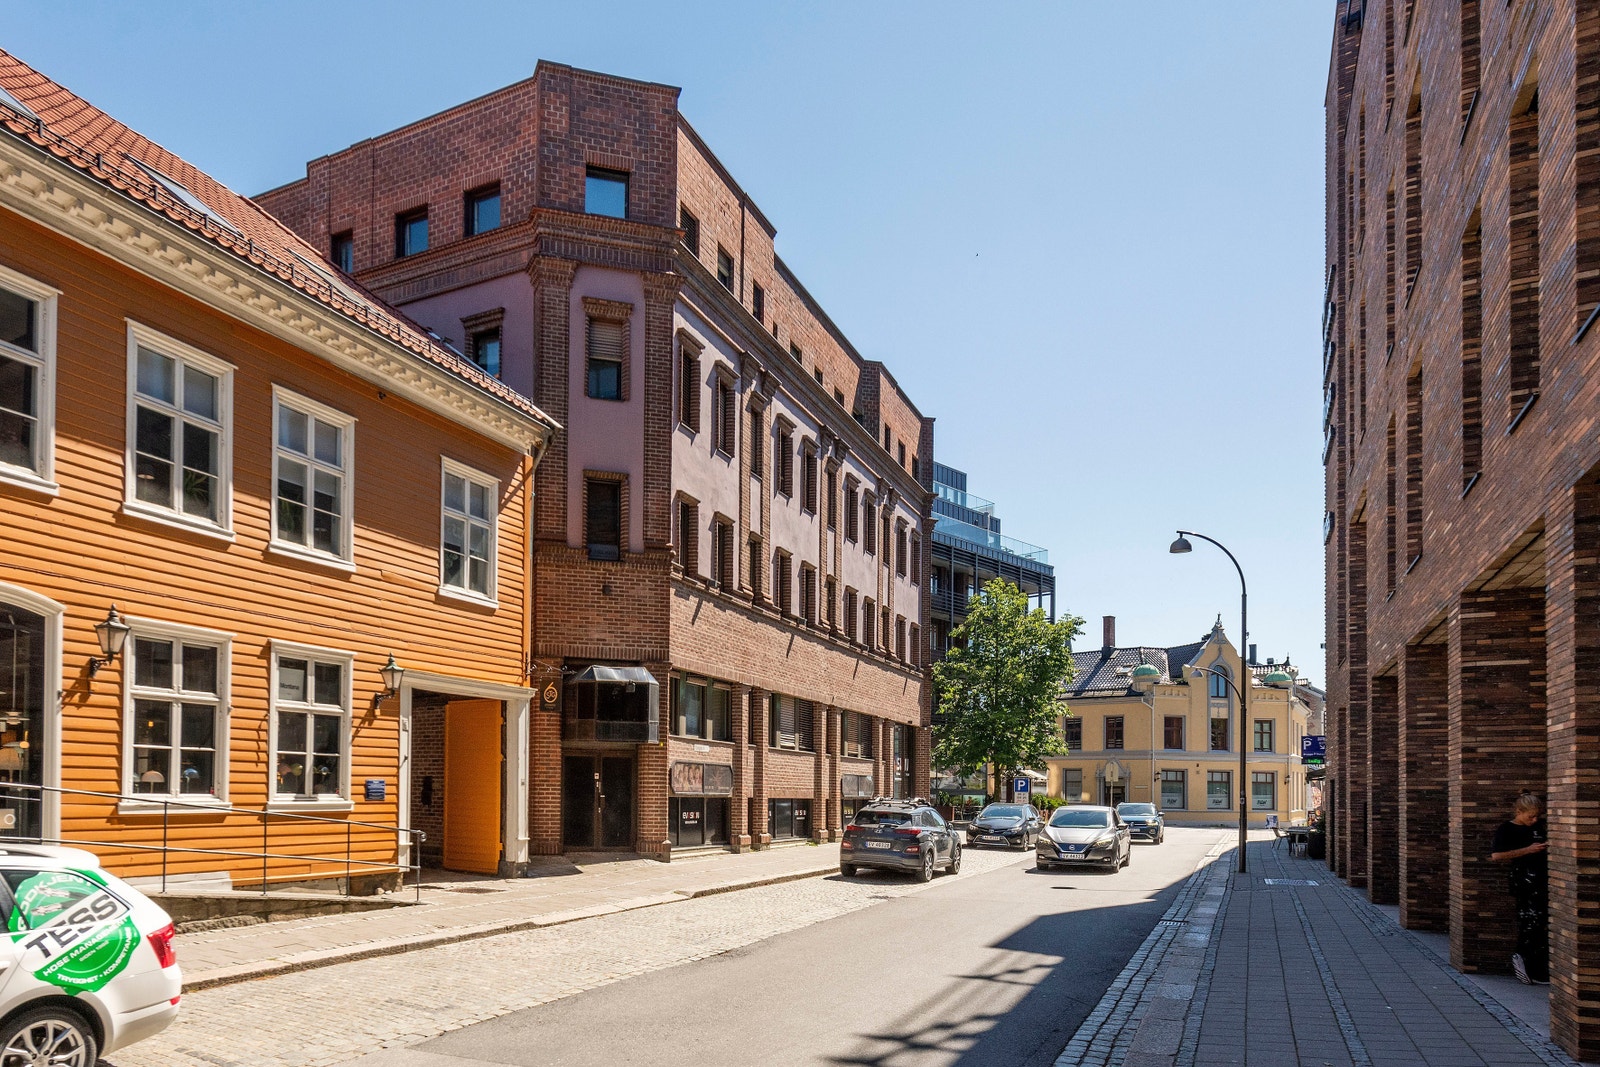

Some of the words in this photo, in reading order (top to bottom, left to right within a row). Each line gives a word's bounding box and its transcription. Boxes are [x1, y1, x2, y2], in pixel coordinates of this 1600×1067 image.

[1303, 740, 1312, 750] P
[1018, 780, 1026, 791] P
[24, 894, 118, 959] TESS
[42, 956, 71, 977] HOSE
[70, 917, 128, 960] MANAGEMENT
